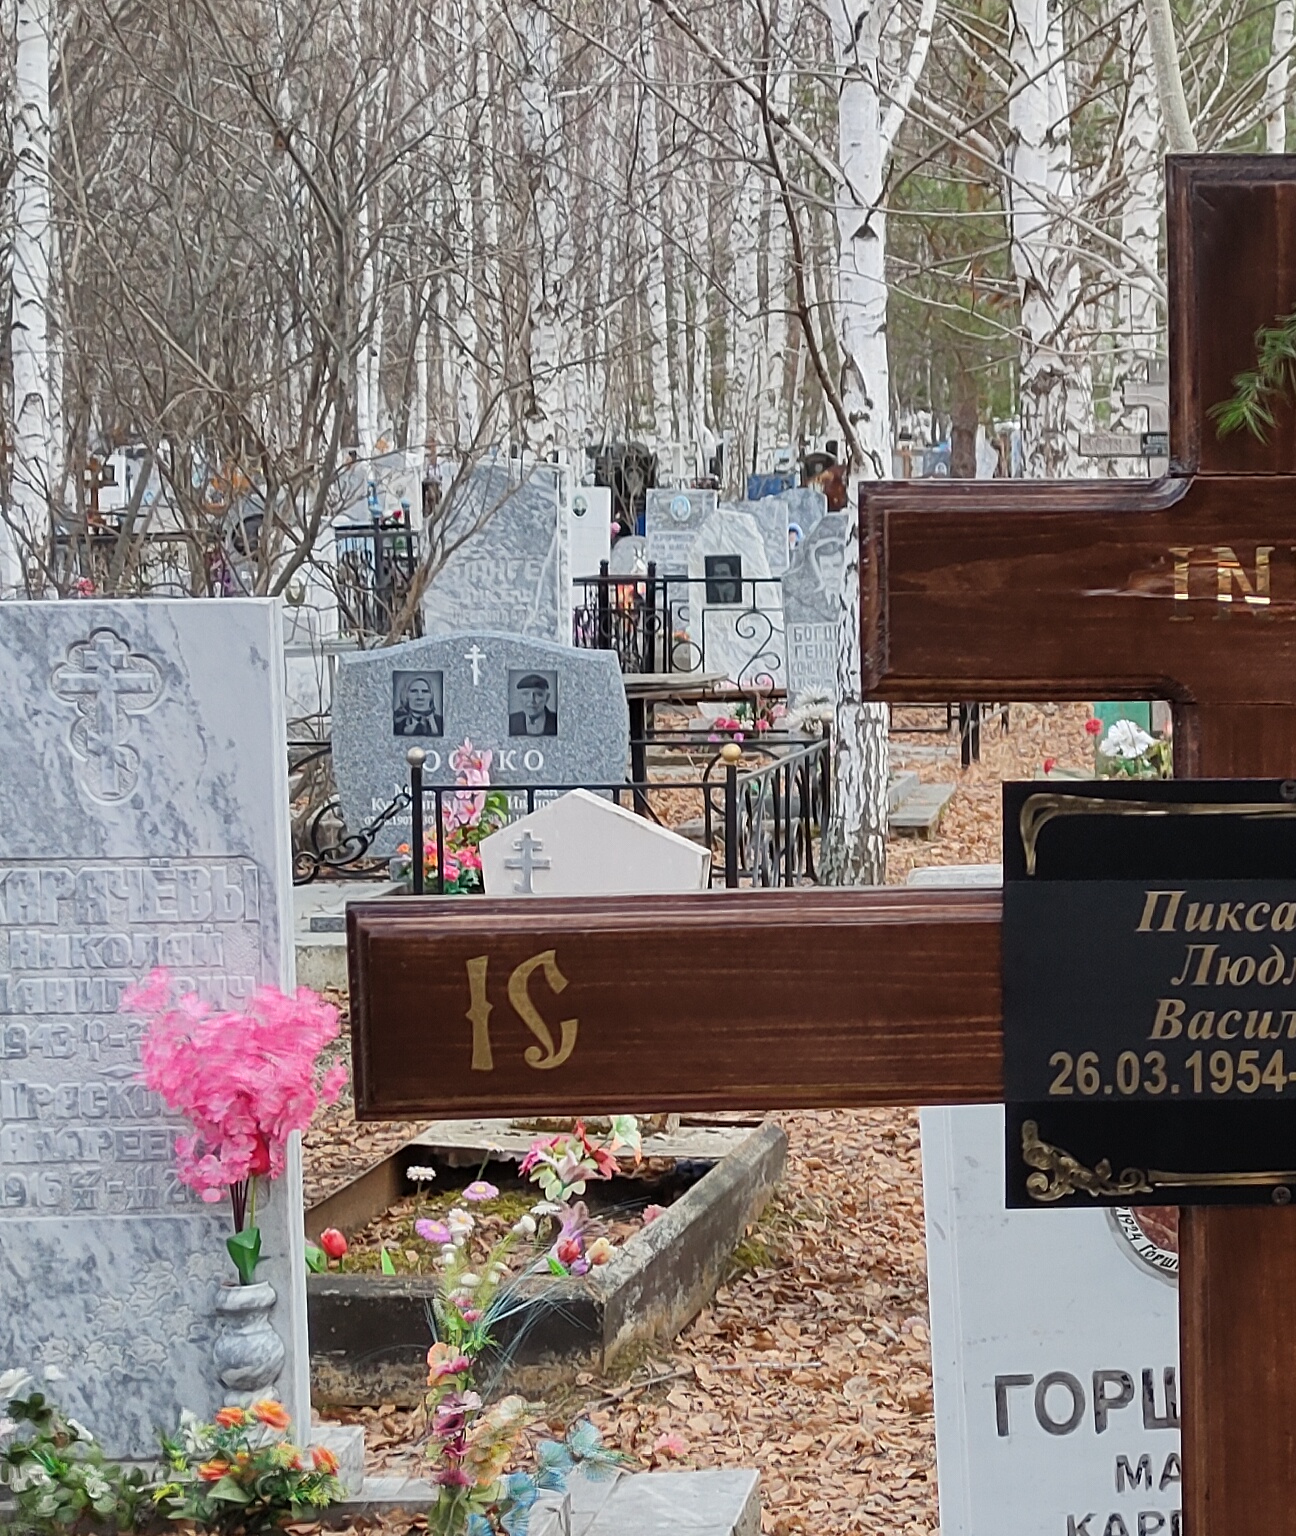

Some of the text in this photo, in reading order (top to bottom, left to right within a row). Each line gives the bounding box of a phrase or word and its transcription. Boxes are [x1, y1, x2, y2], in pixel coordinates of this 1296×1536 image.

[9, 923, 223, 969] НИКОЛАЙ
[1, 1079, 180, 1120] ПРАСКО
[1115, 1452, 1181, 1493] МА
